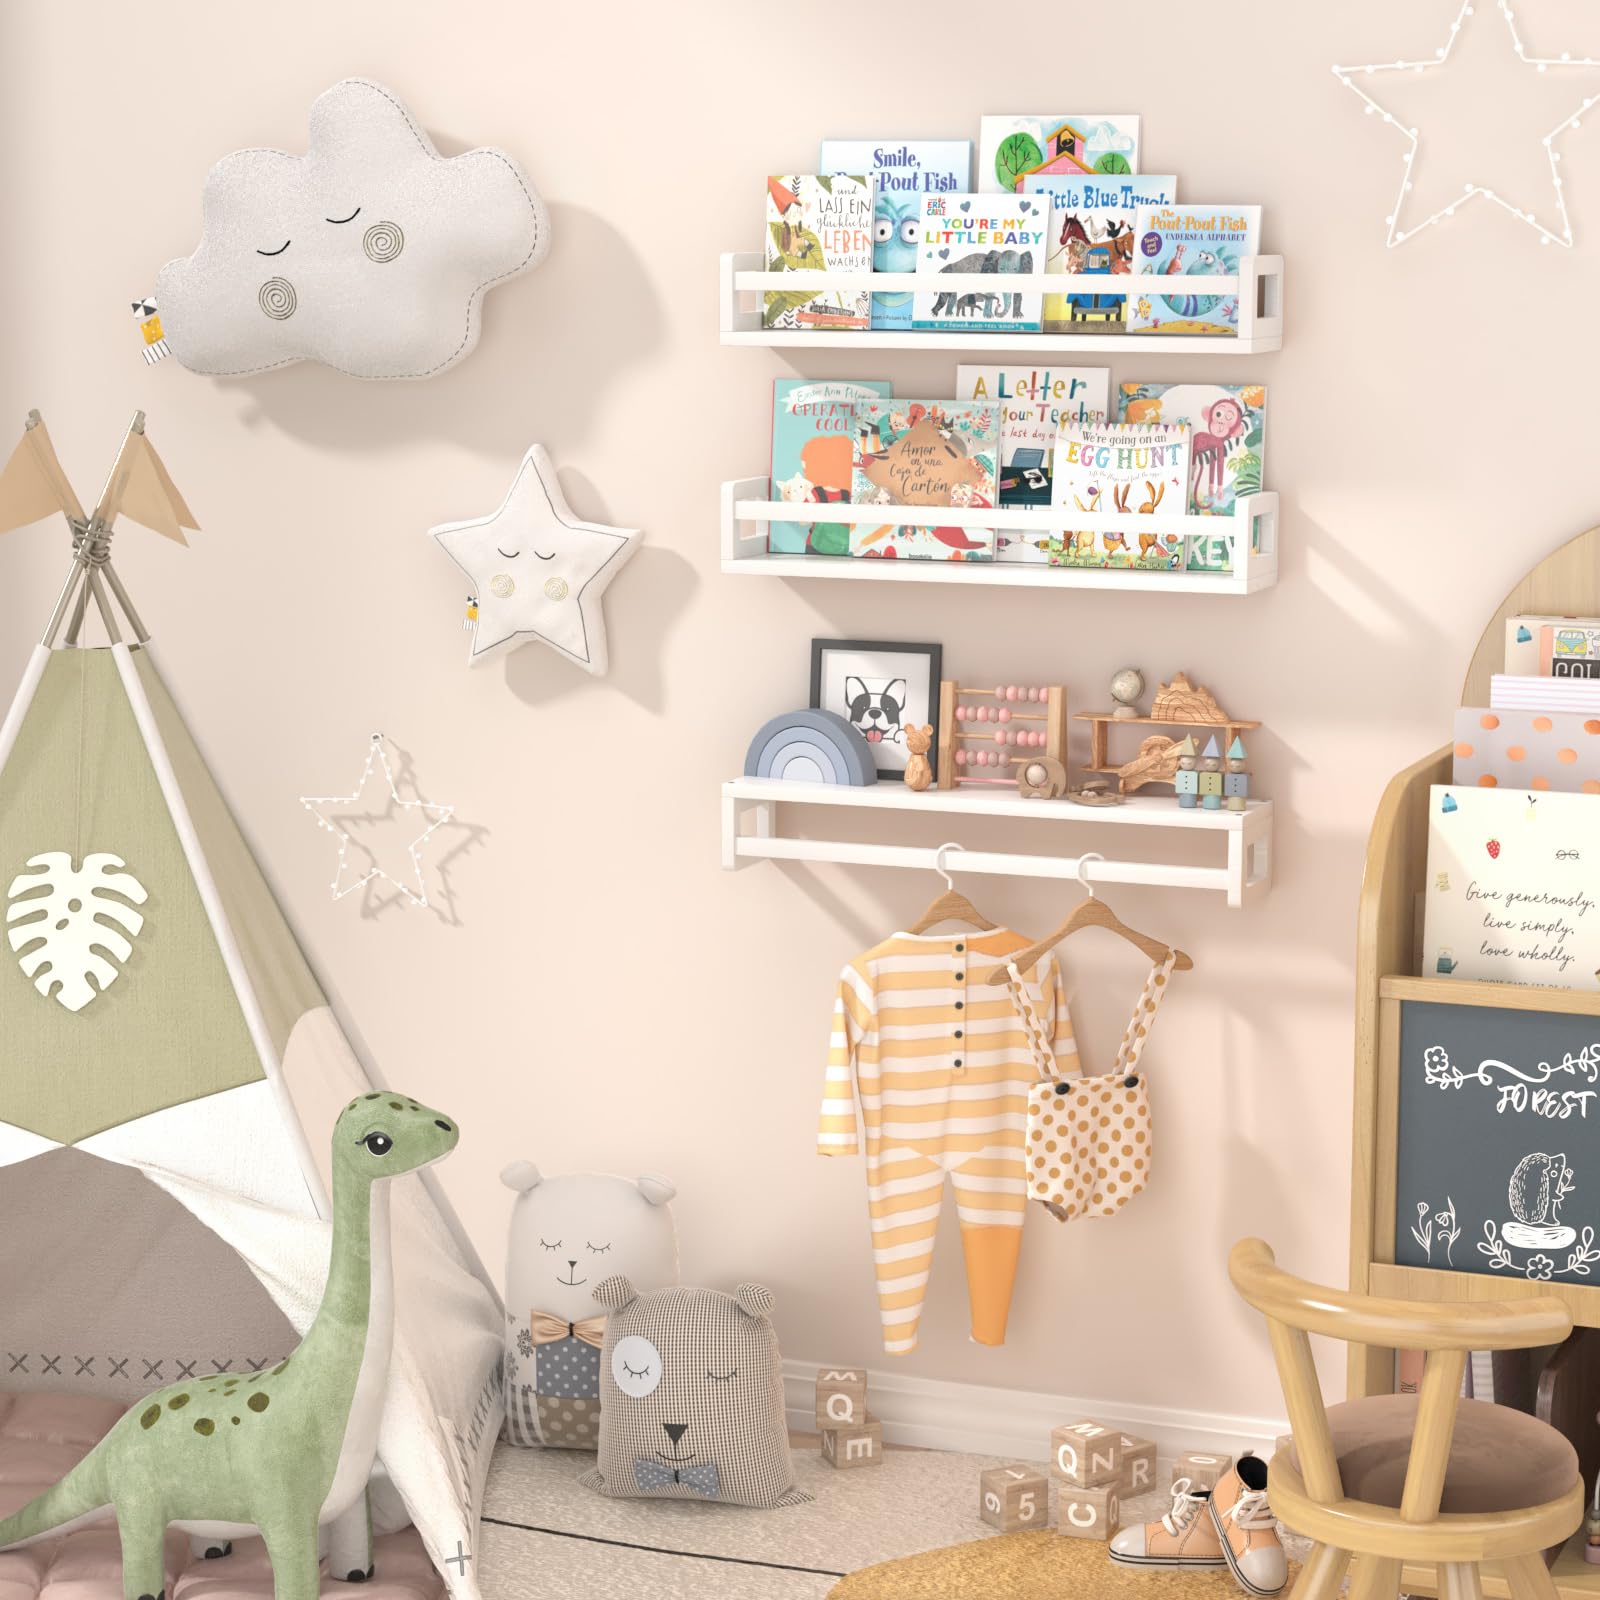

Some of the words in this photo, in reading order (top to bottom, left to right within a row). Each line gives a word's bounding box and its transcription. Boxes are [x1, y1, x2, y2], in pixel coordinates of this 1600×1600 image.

[873, 146, 921, 169] Smile,
[837, 185, 857, 195] und
[923, 171, 958, 193] Fish
[819, 196, 843, 214] LASS
[849, 197, 872, 215] EIN
[927, 201, 946, 209] ERIC
[1036, 188, 1079, 209] ttle
[1084, 185, 1118, 209] Blue
[926, 208, 946, 216] CARLE
[1161, 209, 1175, 217] The
[942, 218, 998, 230] YOU'RE
[1003, 218, 1027, 230] MY
[1150, 216, 1217, 231] Pout-Pout
[1220, 216, 1247, 231] Fish
[824, 230, 872, 254] LEBEN
[925, 231, 987, 244] LITTLE
[993, 231, 1044, 245] BABY
[1207, 233, 1247, 241] ALPHABET
[973, 376, 989, 400] A
[998, 371, 1087, 401] Letter
[1036, 404, 1104, 424] Teacher
[1010, 427, 1027, 437] last
[1082, 431, 1107, 443] We're
[1109, 437, 1136, 447] going
[1139, 435, 1152, 444] on
[1154, 434, 1167, 443] an
[901, 441, 936, 458] Amor
[1066, 441, 1111, 469] EGG
[1117, 443, 1183, 470] HUNT
[890, 464, 911, 481] Caja
[914, 465, 926, 477] de
[924, 459, 944, 467] una
[902, 475, 950, 497] Cartón
[1466, 880, 1502, 901] Give
[1506, 891, 1596, 917] generously.
[1482, 912, 1516, 928] live
[1520, 918, 1575, 943] simply.
[1480, 940, 1514, 957] love
[1518, 944, 1576, 972] wholly.
[1496, 1083, 1598, 1119] FOREST
[826, 1393, 853, 1424] Q
[824, 1430, 834, 1457] N
[846, 1437, 872, 1461] E
[1058, 1444, 1078, 1479] Q
[1091, 1447, 1114, 1474] N
[1132, 1458, 1149, 1489] R
[1018, 1491, 1036, 1521] 5
[1067, 1502, 1097, 1528] C
[1109, 1495, 1118, 1524] Q
